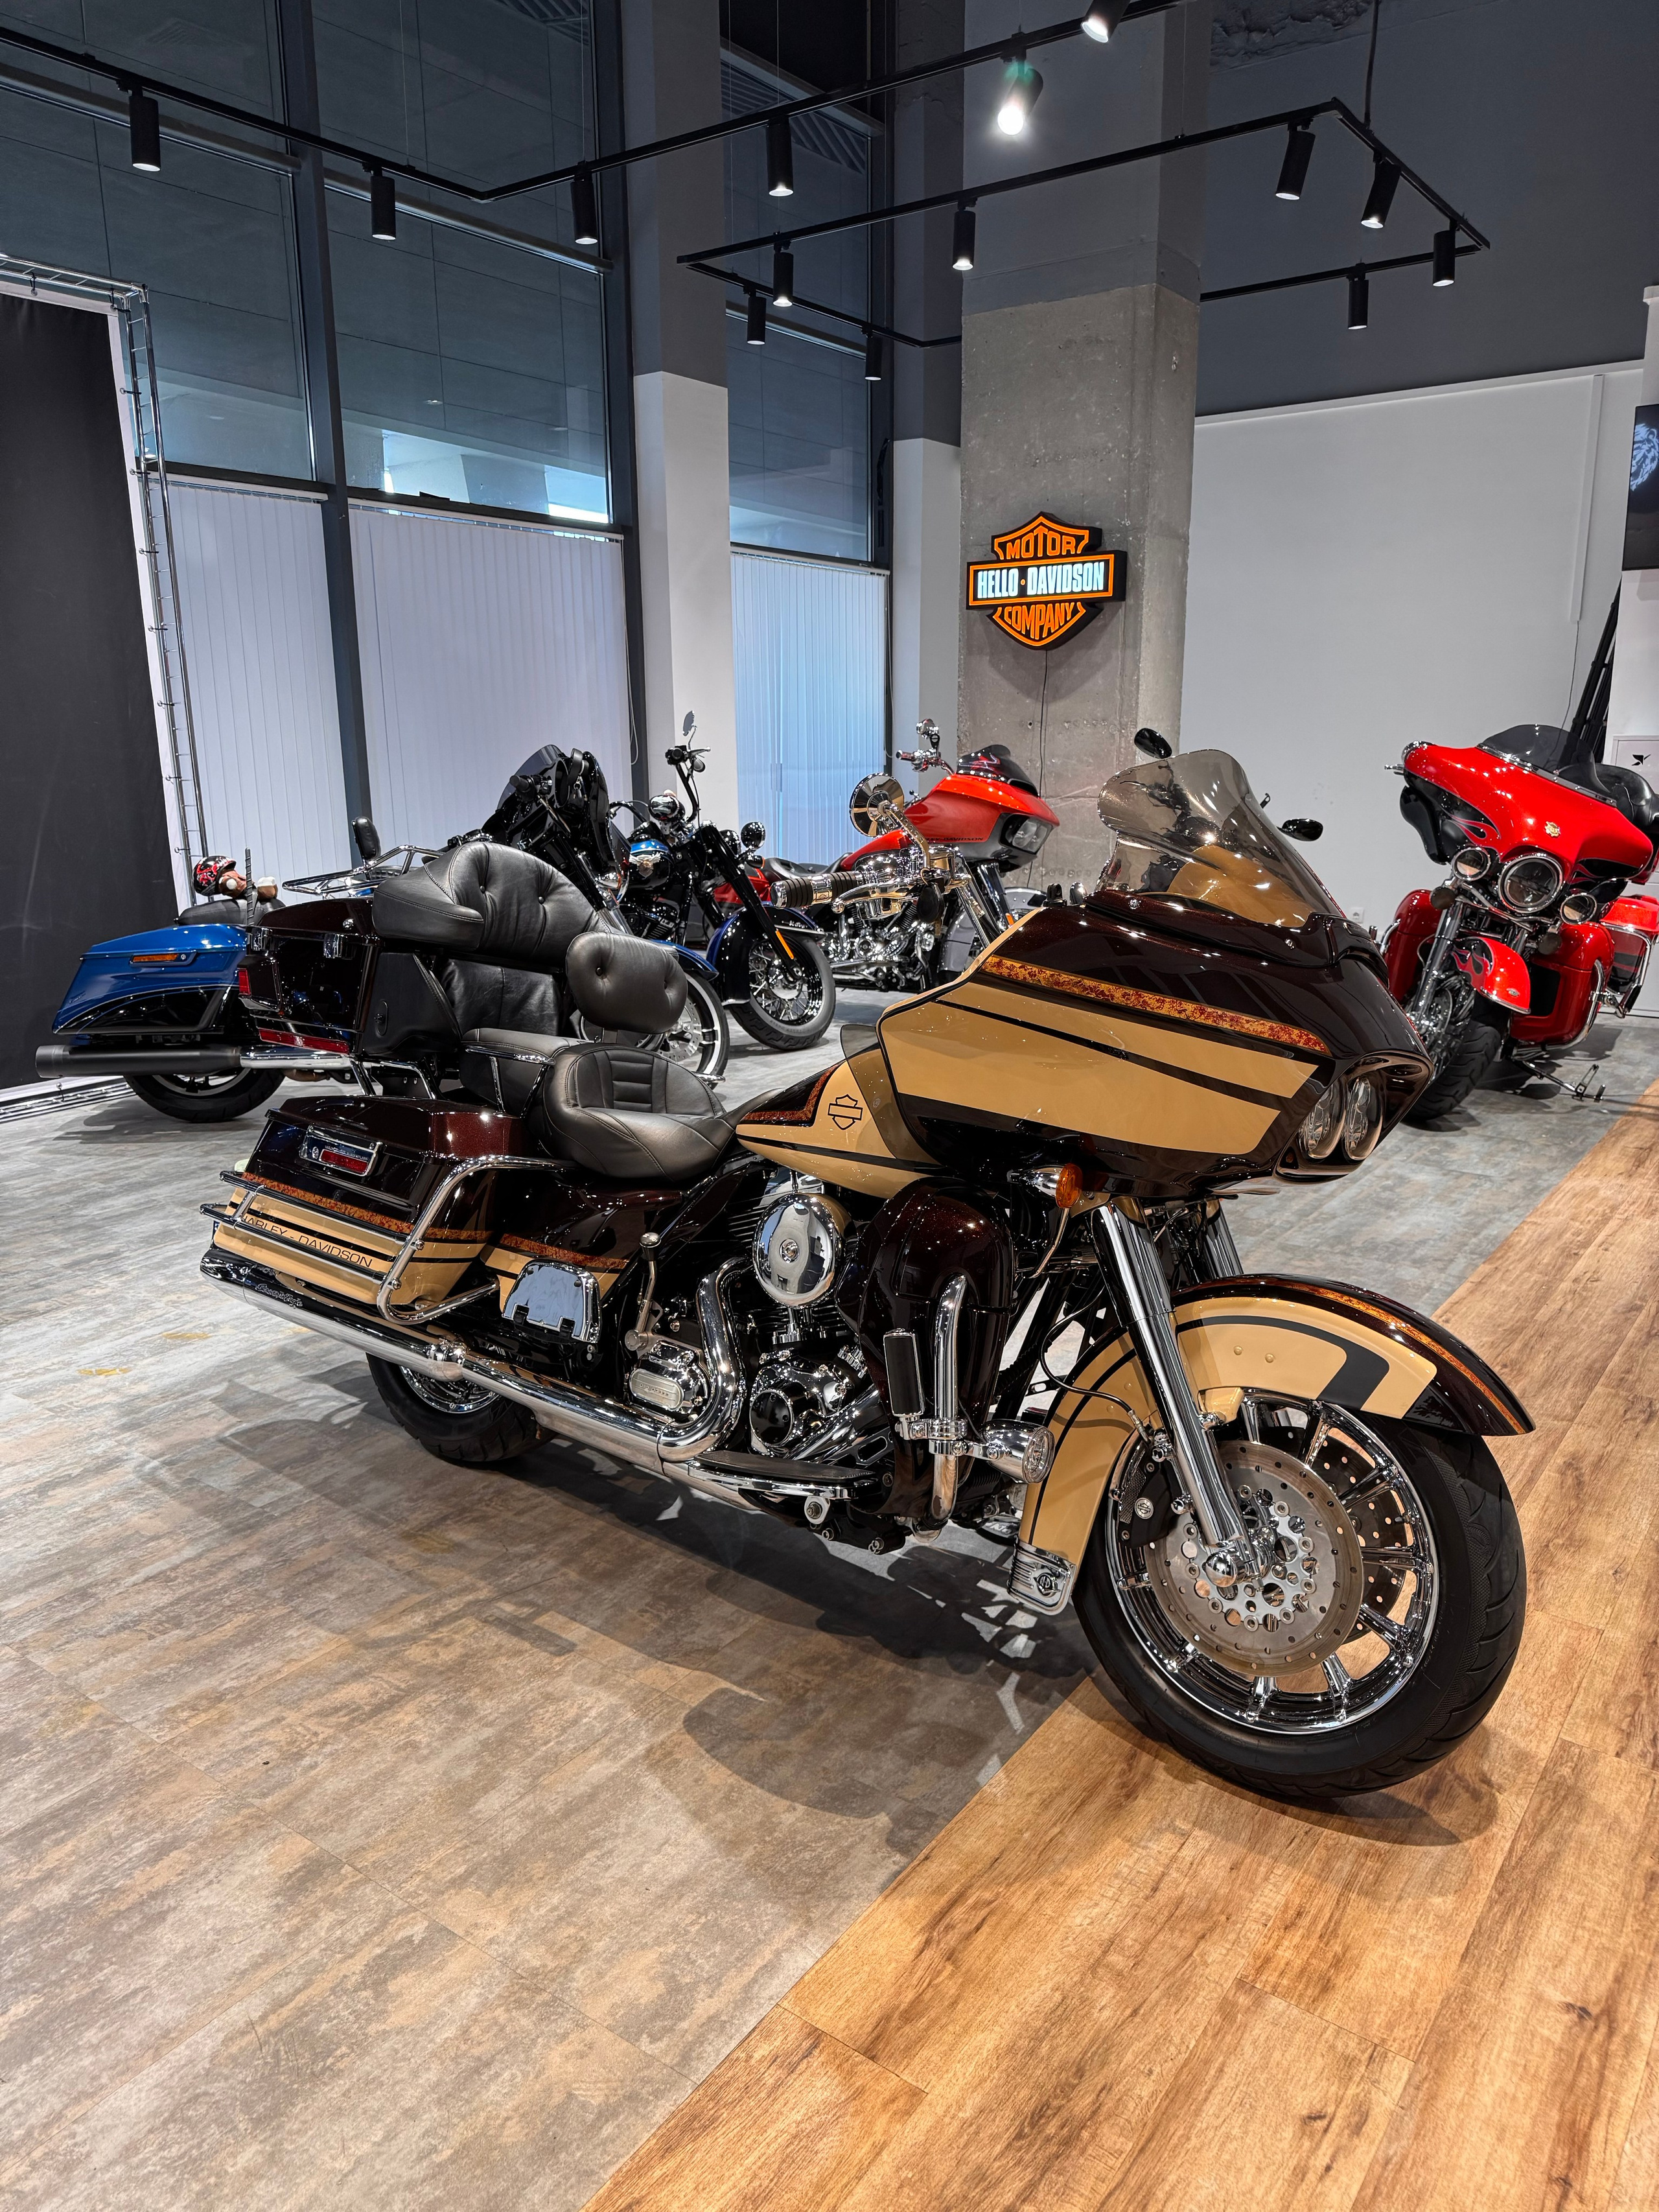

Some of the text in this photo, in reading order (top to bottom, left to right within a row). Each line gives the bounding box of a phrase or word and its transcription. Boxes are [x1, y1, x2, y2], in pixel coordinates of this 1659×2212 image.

[1006, 526, 1076, 559] MOTOR
[977, 561, 1104, 599] HELLO DAVIDSON
[1004, 602, 1074, 640] COMPANY
[299, 1235, 373, 1268] DAVIDSON
